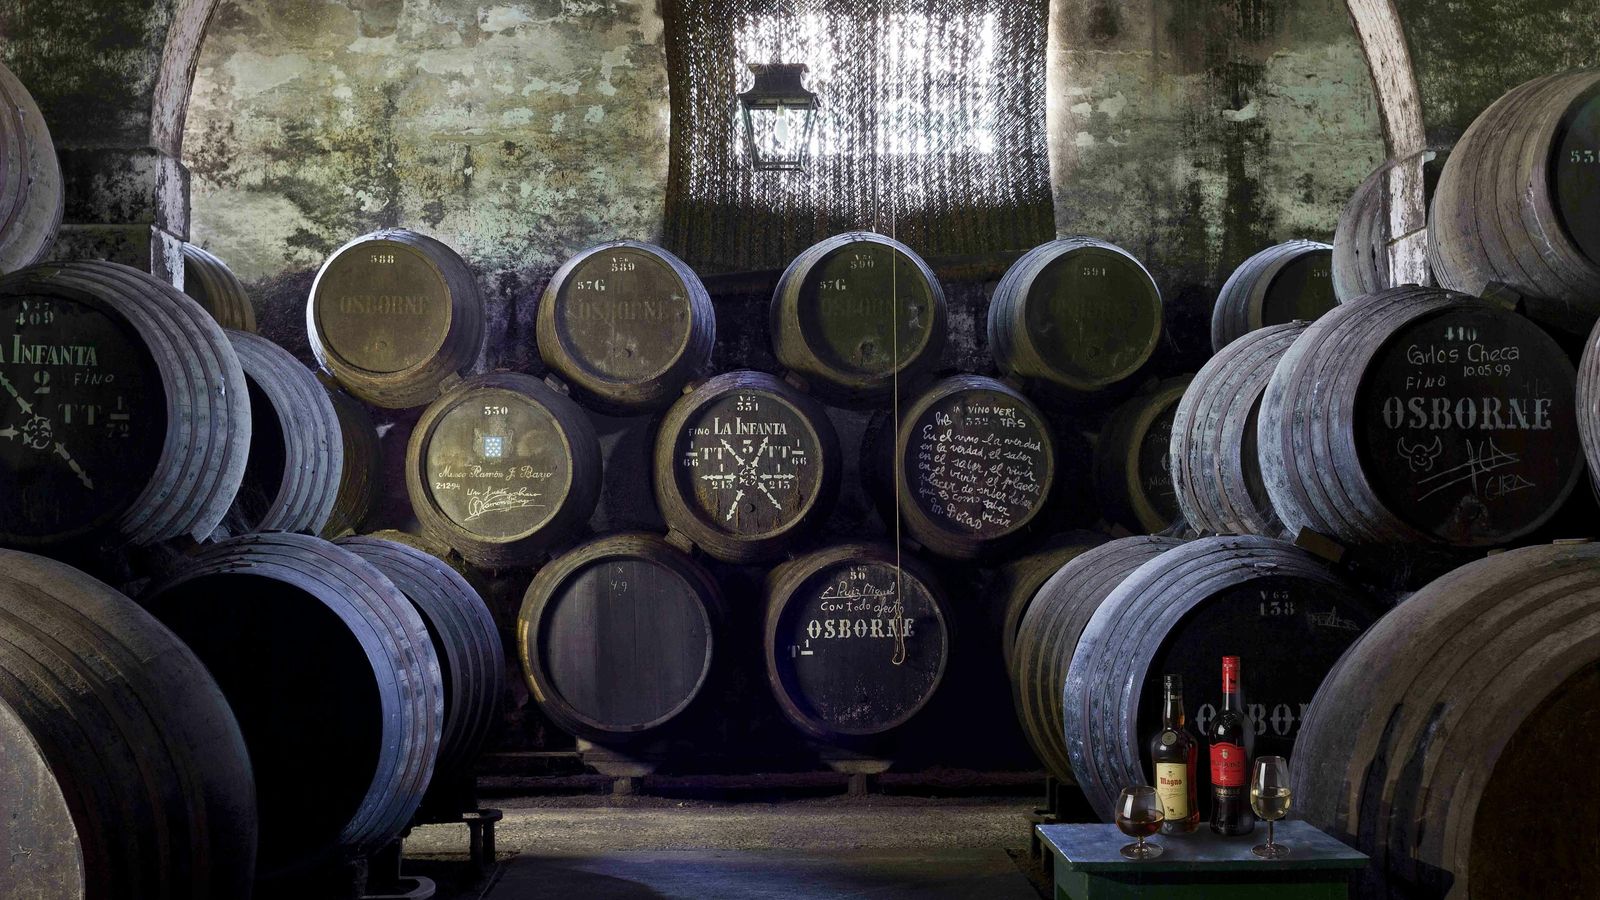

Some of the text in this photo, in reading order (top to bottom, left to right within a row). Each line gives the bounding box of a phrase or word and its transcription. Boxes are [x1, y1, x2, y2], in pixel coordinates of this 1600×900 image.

[370, 255, 395, 264] 588
[611, 263, 636, 272] 589
[12, 334, 98, 366] INFANTA
[1407, 343, 1520, 364] Carlos Checa
[33, 370, 51, 395] 2
[1382, 396, 1552, 431] OSBORNE
[736, 416, 788, 436] INFANTA
[806, 619, 915, 639] OSBORNE
[1160, 777, 1183, 786] Magno
